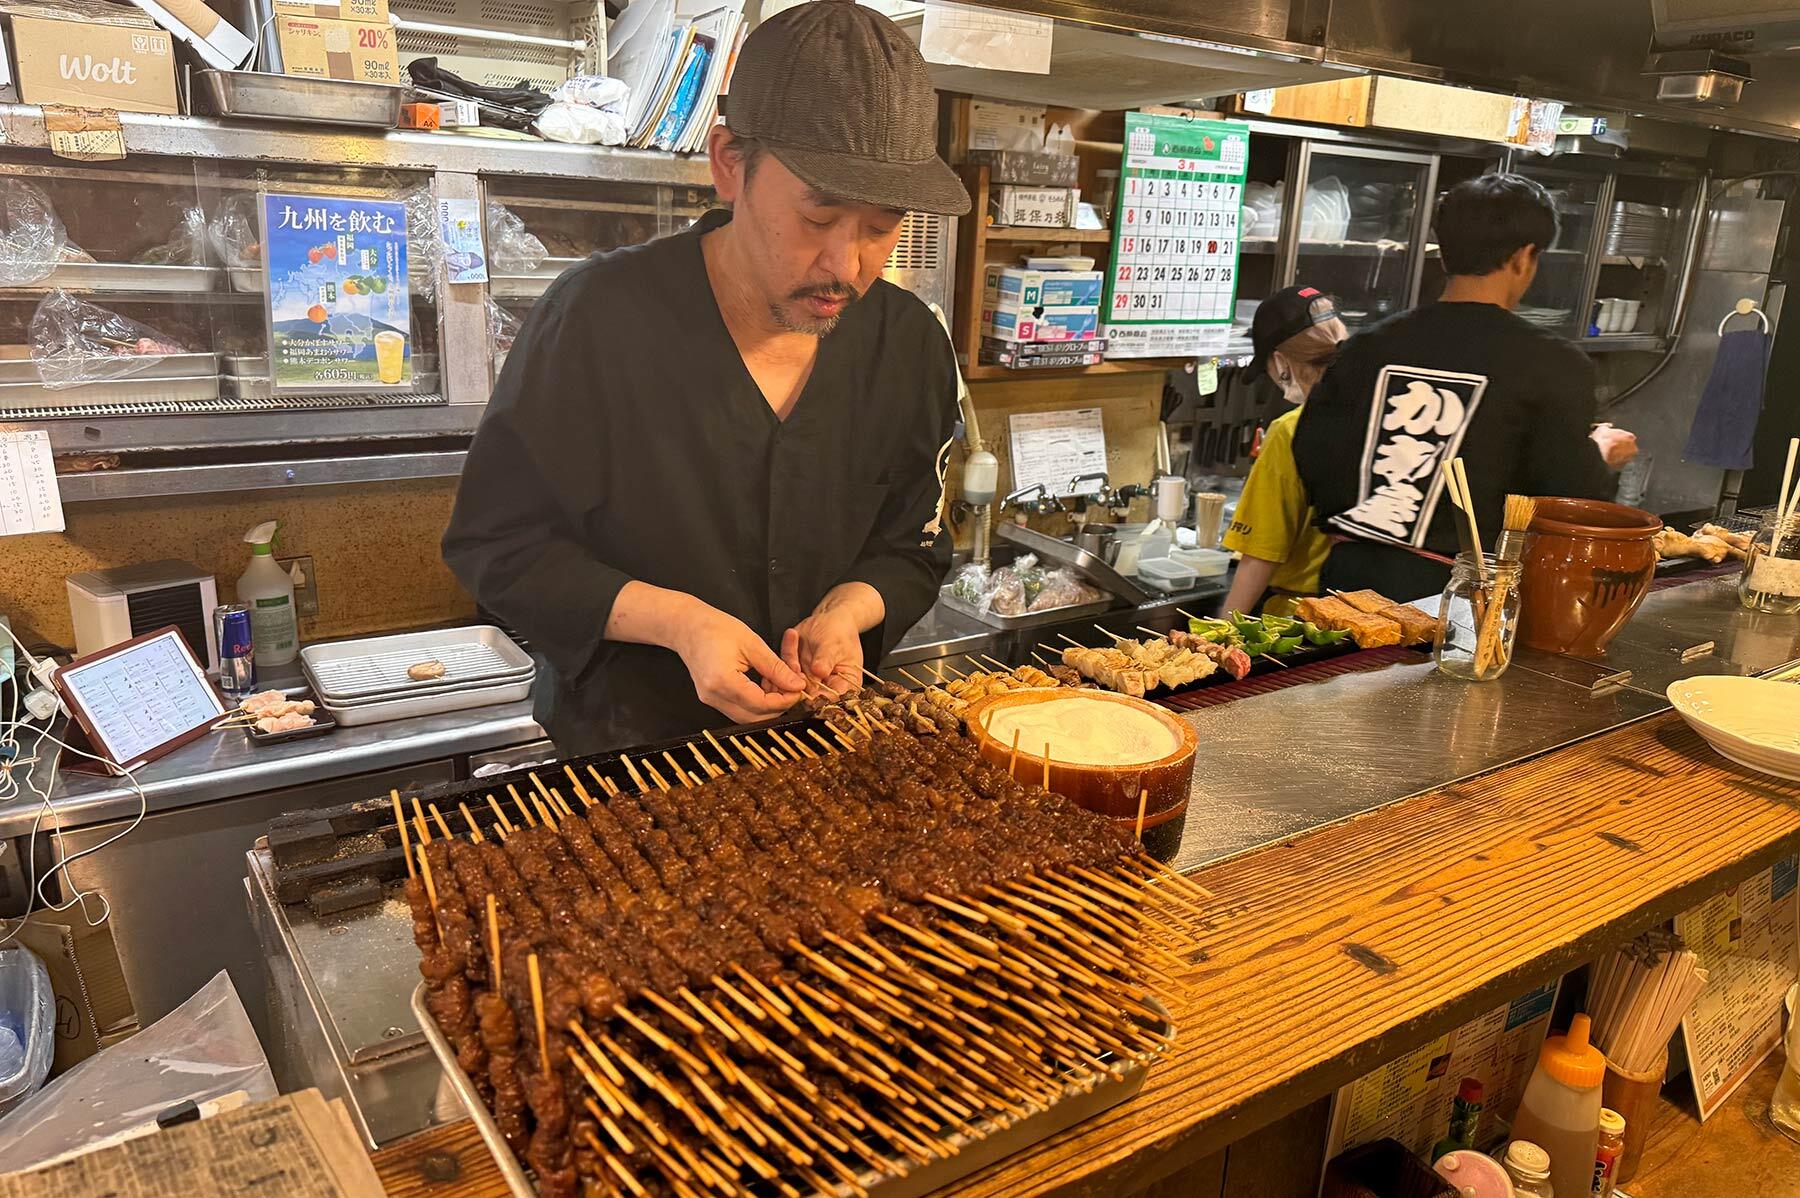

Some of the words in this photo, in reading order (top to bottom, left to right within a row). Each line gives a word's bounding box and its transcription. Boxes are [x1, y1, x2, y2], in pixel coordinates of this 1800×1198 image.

[358, 28, 389, 49] 20%
[59, 54, 137, 85] Wolt
[1131, 180, 1136, 194] 1
[1148, 181, 1154, 195] 2
[1165, 182, 1171, 197] 3
[1181, 183, 1187, 197] 4
[1197, 184, 1203, 198] 5
[1213, 185, 1219, 198] 6
[1229, 187, 1235, 199] 7
[278, 205, 395, 234] 九州を飲む
[1127, 209, 1134, 224] 8
[1145, 210, 1152, 224] 9
[1161, 210, 1171, 225] 10
[1177, 211, 1186, 225] 11
[1194, 212, 1204, 226] 12
[1210, 213, 1219, 226] 13
[1226, 214, 1235, 227] 14
[1122, 238, 1134, 252] 15
[1141, 239, 1151, 253] 16
[1158, 239, 1169, 253] 17
[1175, 239, 1185, 253] 18
[1192, 240, 1201, 254] 19
[1207, 240, 1218, 254] 20
[1224, 241, 1233, 254] 21
[1119, 266, 1131, 280] 22
[1137, 267, 1149, 280] 23
[1154, 267, 1165, 281] 24
[1171, 267, 1182, 280] 25
[1188, 268, 1199, 281] 26
[1204, 268, 1215, 281] 27
[1221, 269, 1231, 281] 28
[1026, 291, 1036, 301] M
[1115, 294, 1128, 308] 29
[1134, 295, 1145, 308] 30
[1151, 295, 1162, 308] 31
[1022, 327, 1030, 335] S
